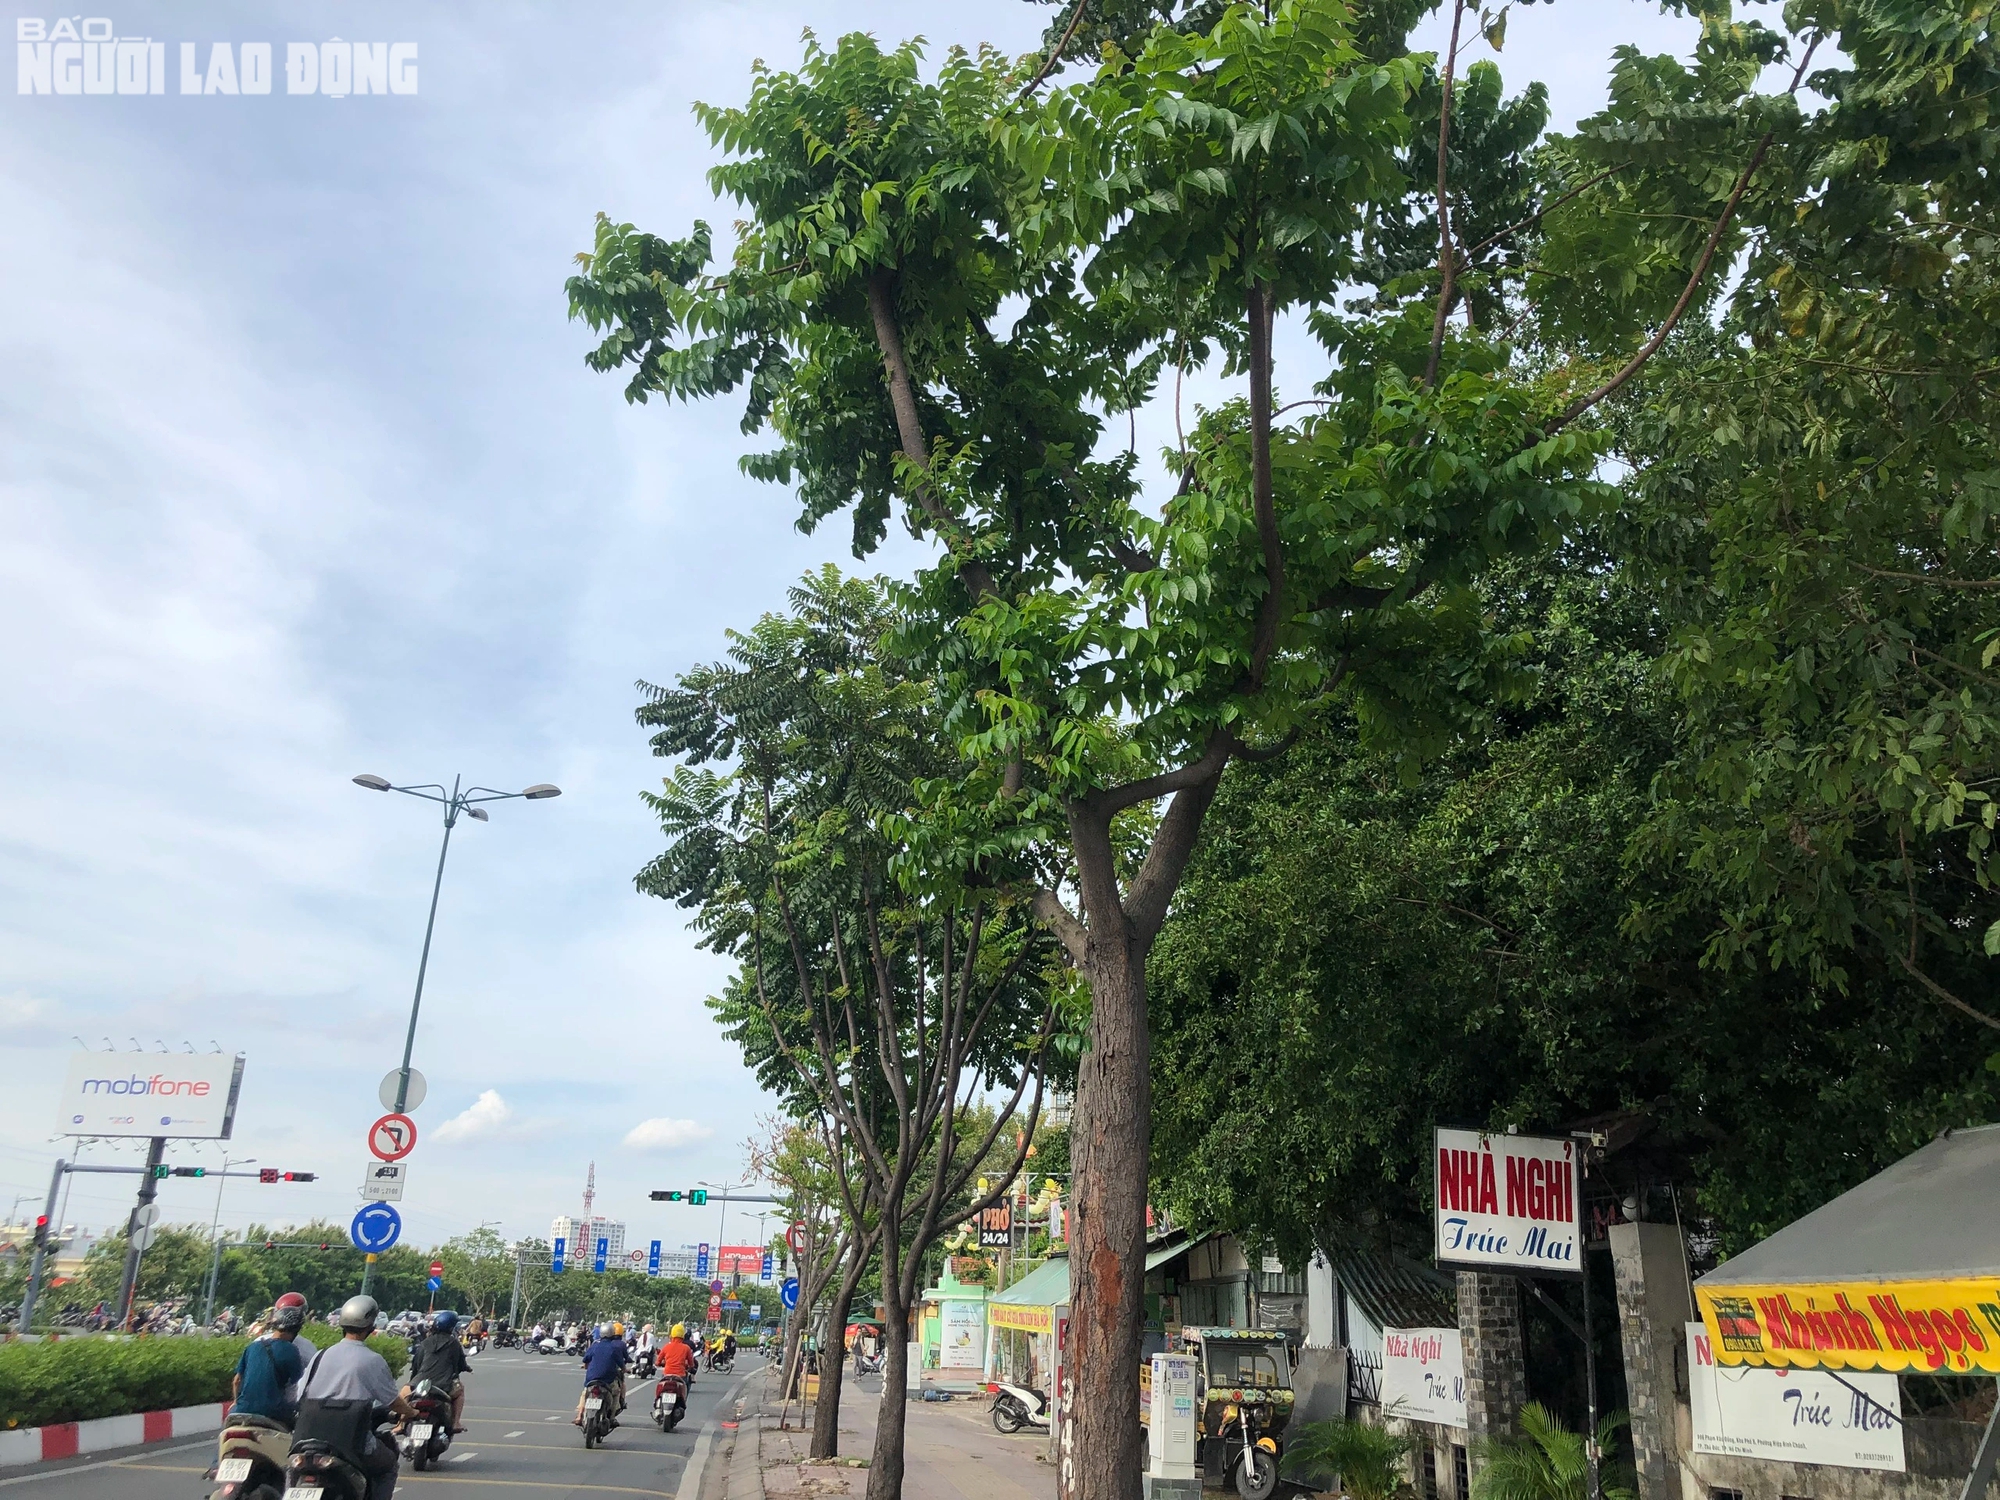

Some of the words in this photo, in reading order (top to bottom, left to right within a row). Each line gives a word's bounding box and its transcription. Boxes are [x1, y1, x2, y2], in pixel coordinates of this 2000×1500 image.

[82, 1074, 210, 1096] mobifone
[1440, 1139, 1498, 1215] NHÀ
[1506, 1141, 1573, 1223] NGHỈ
[693, 1191, 706, 1204] 17
[982, 1198, 1010, 1230] PHỞ
[982, 1232, 1009, 1244] 24/24
[1442, 1217, 1509, 1254] Trúc
[1516, 1226, 1574, 1260] Mai
[1757, 1292, 1883, 1351] Khánh
[1867, 1293, 1990, 1370] Ngọc
[1386, 1334, 1409, 1357] Nhà
[1412, 1334, 1442, 1365] Nghỉ
[1424, 1373, 1447, 1399] Trúc
[1783, 1389, 1833, 1427] Trúc
[1842, 1390, 1895, 1431] Mai
